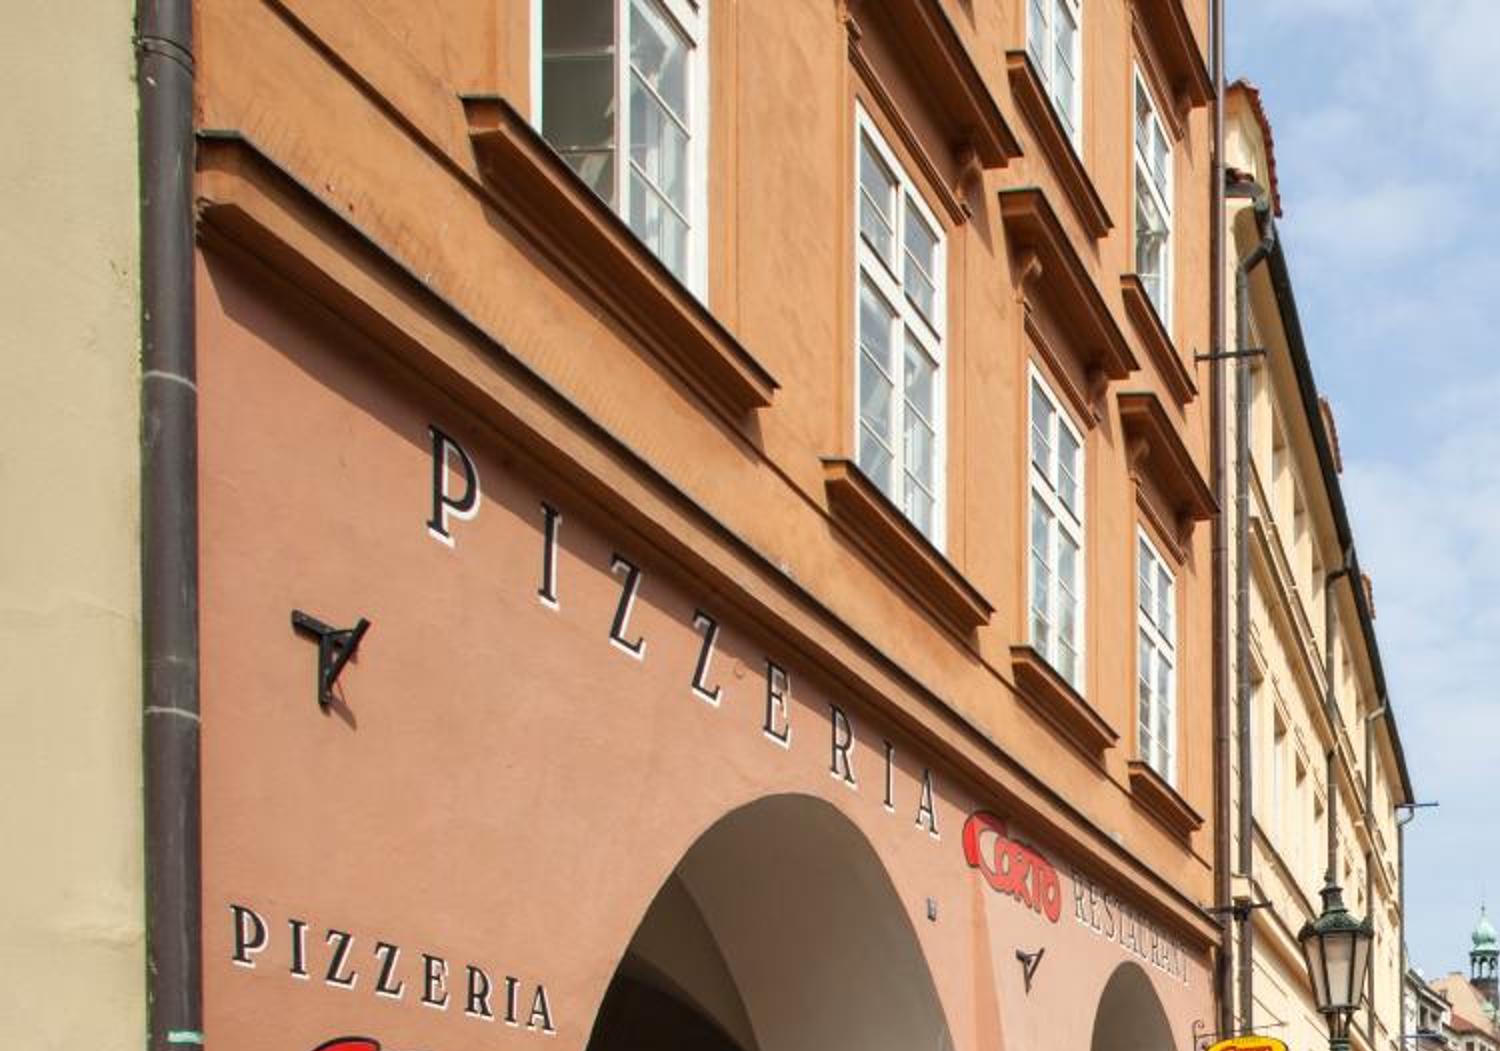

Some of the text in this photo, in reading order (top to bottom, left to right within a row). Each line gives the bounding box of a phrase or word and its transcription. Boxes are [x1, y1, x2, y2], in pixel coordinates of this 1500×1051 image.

[426, 424, 1190, 986] PIZZERIA CORTO RESTAURANT
[229, 904, 558, 1036] PIZZERIA
